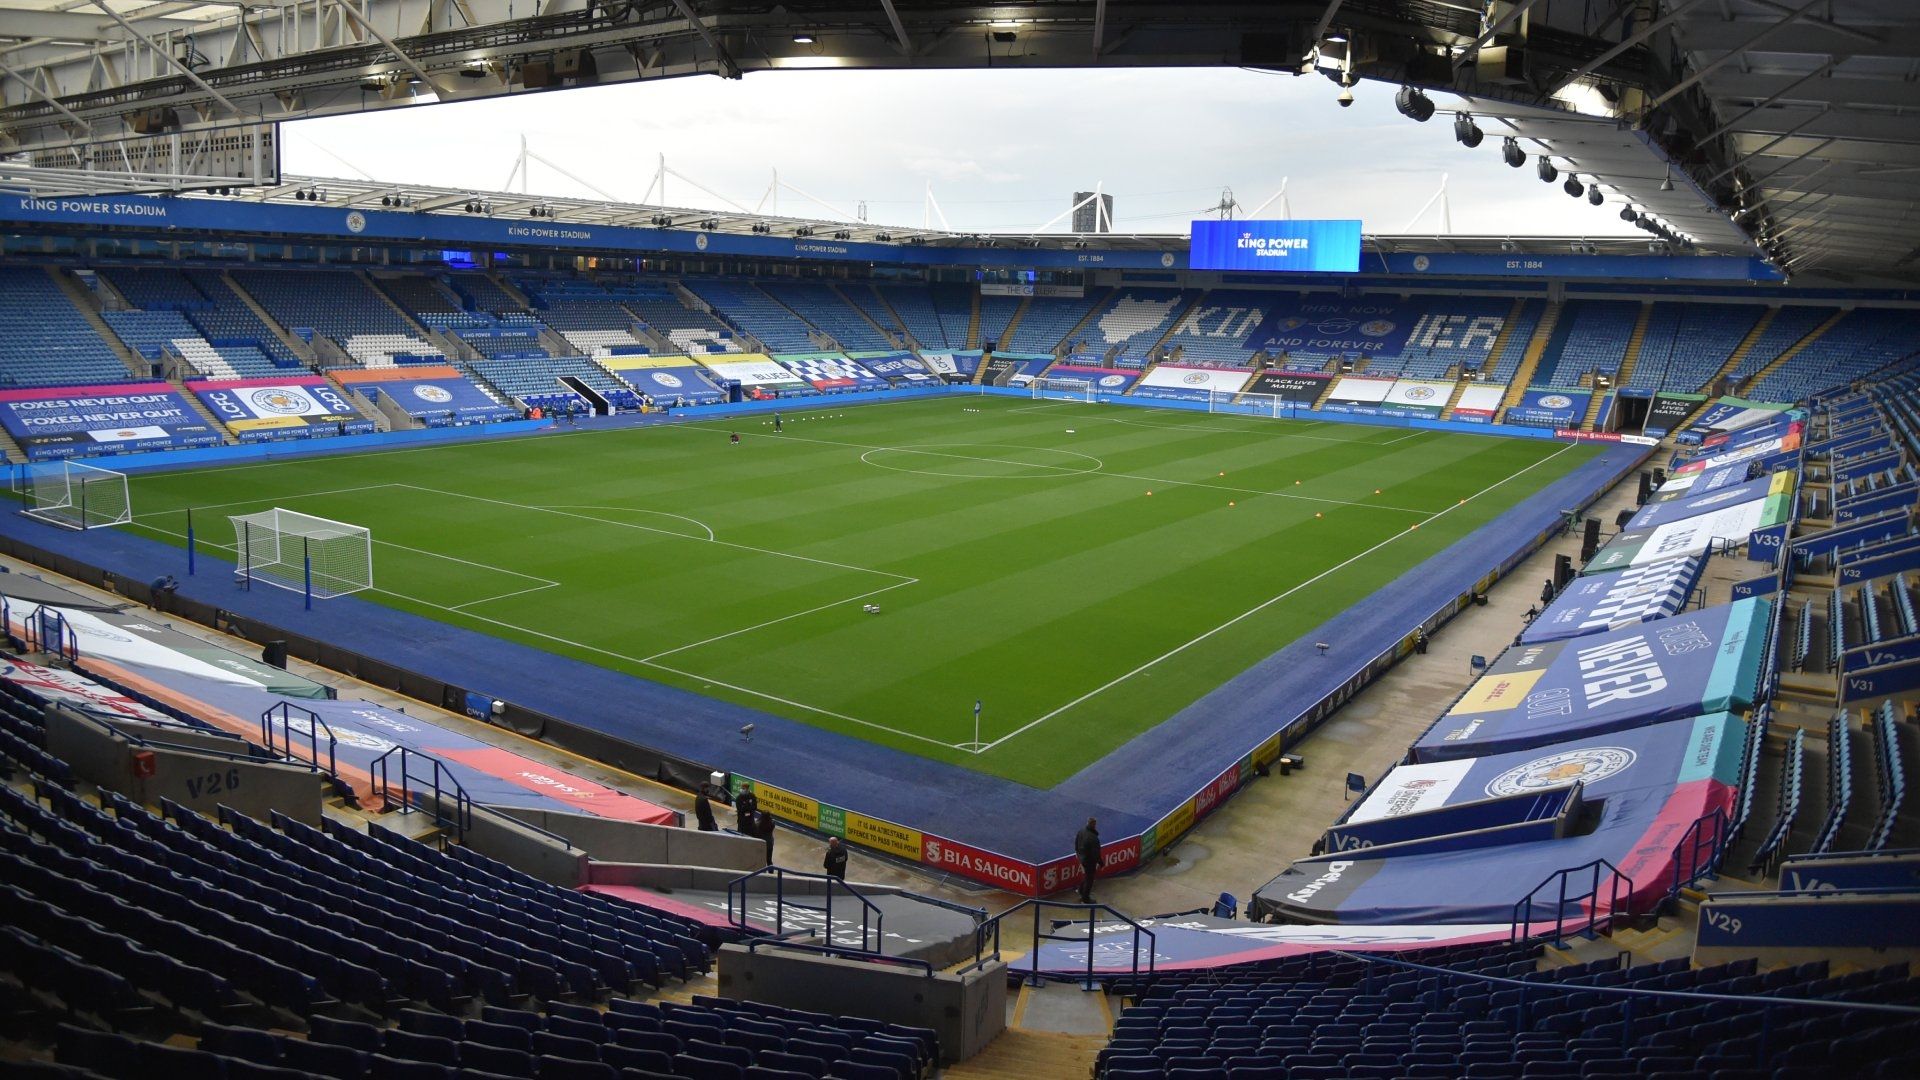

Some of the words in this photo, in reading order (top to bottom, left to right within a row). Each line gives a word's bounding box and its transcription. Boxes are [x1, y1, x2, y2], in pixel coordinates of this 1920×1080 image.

[20, 200, 57, 211] KING
[62, 202, 109, 214] POWER
[114, 204, 166, 216] STADIUM
[508, 227, 529, 236] KING
[531, 228, 558, 238] POWER
[560, 230, 591, 239] STADIUM
[1237, 238, 1266, 248] KING
[1269, 239, 1308, 249] POWER
[1506, 261, 1521, 269] EST.
[1523, 261, 1543, 269] 1884
[1350, 306, 1395, 315] NOW
[1264, 337, 1302, 347] AND
[1307, 339, 1384, 351] FOREVER
[8, 400, 71, 410] FOXES
[71, 397, 129, 408] NEVER
[130, 395, 168, 404] QUIT
[210, 392, 247, 418] LCFC
[314, 388, 350, 412] LCFC
[22, 415, 83, 426] FOXES
[83, 412, 141, 422] NEVER
[143, 409, 182, 417] QUIT
[1754, 533, 1780, 547] V33
[1843, 568, 1861, 578] V32
[1735, 586, 1752, 594] V33
[1577, 635, 1667, 709] NEVER
[1850, 679, 1873, 691] V31
[187, 768, 239, 799] V26
[847, 827, 869, 840] OFFENCE
[904, 843, 919, 854] POINT
[944, 849, 971, 868] BIA
[1061, 865, 1085, 880] BIA
[1286, 860, 1354, 904] betway
[1706, 908, 1742, 934] V29
